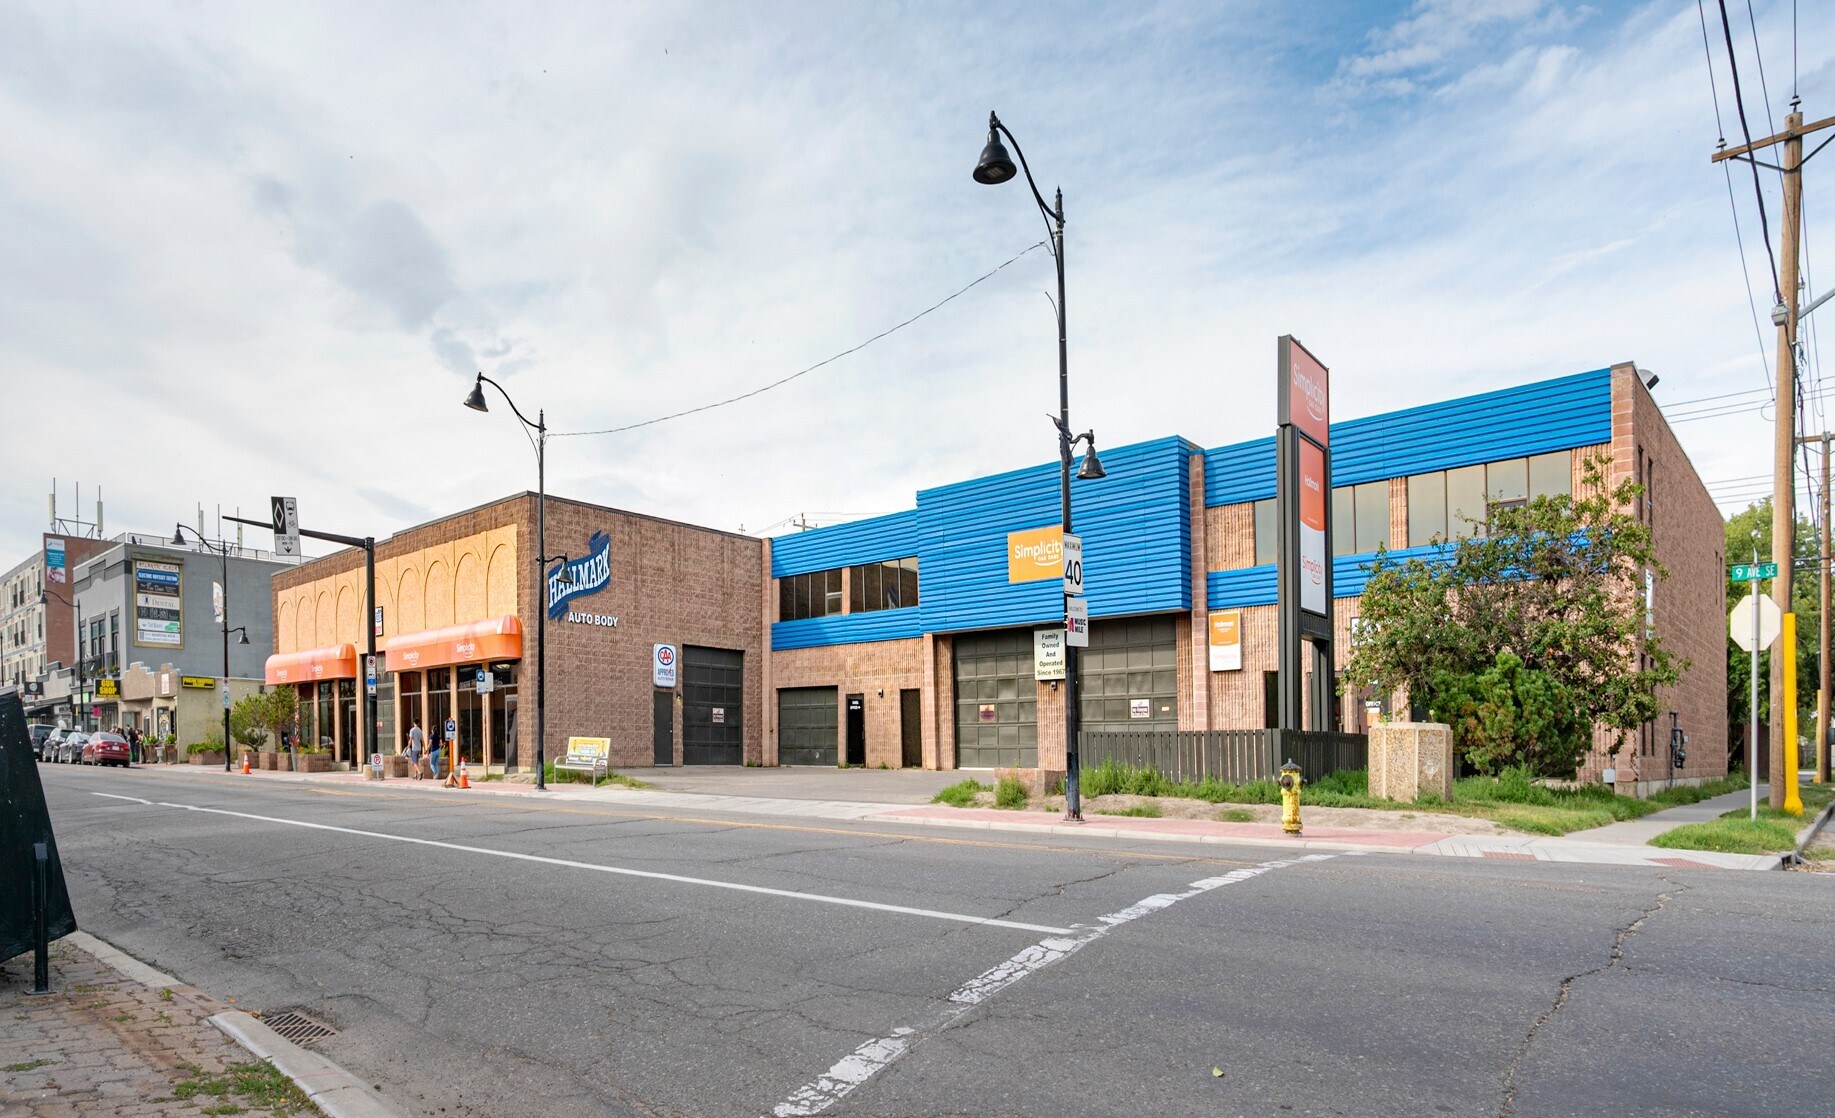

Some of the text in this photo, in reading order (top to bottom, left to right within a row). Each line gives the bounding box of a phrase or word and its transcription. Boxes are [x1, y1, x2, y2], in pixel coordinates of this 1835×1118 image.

[1293, 363, 1325, 413] Simplicity
[1014, 540, 1063, 560] Simplicity
[1065, 559, 1082, 586] 40
[1302, 554, 1323, 579] Simplicity
[1735, 565, 1775, 578] 9 AVE SE
[568, 612, 618, 627] AUTO BODY
[1075, 618, 1086, 626] MUSIC
[457, 642, 476, 653] Simplicity
[660, 649, 672, 662] CAA
[101, 679, 115, 687] GUN
[99, 687, 117, 695] SHOP
